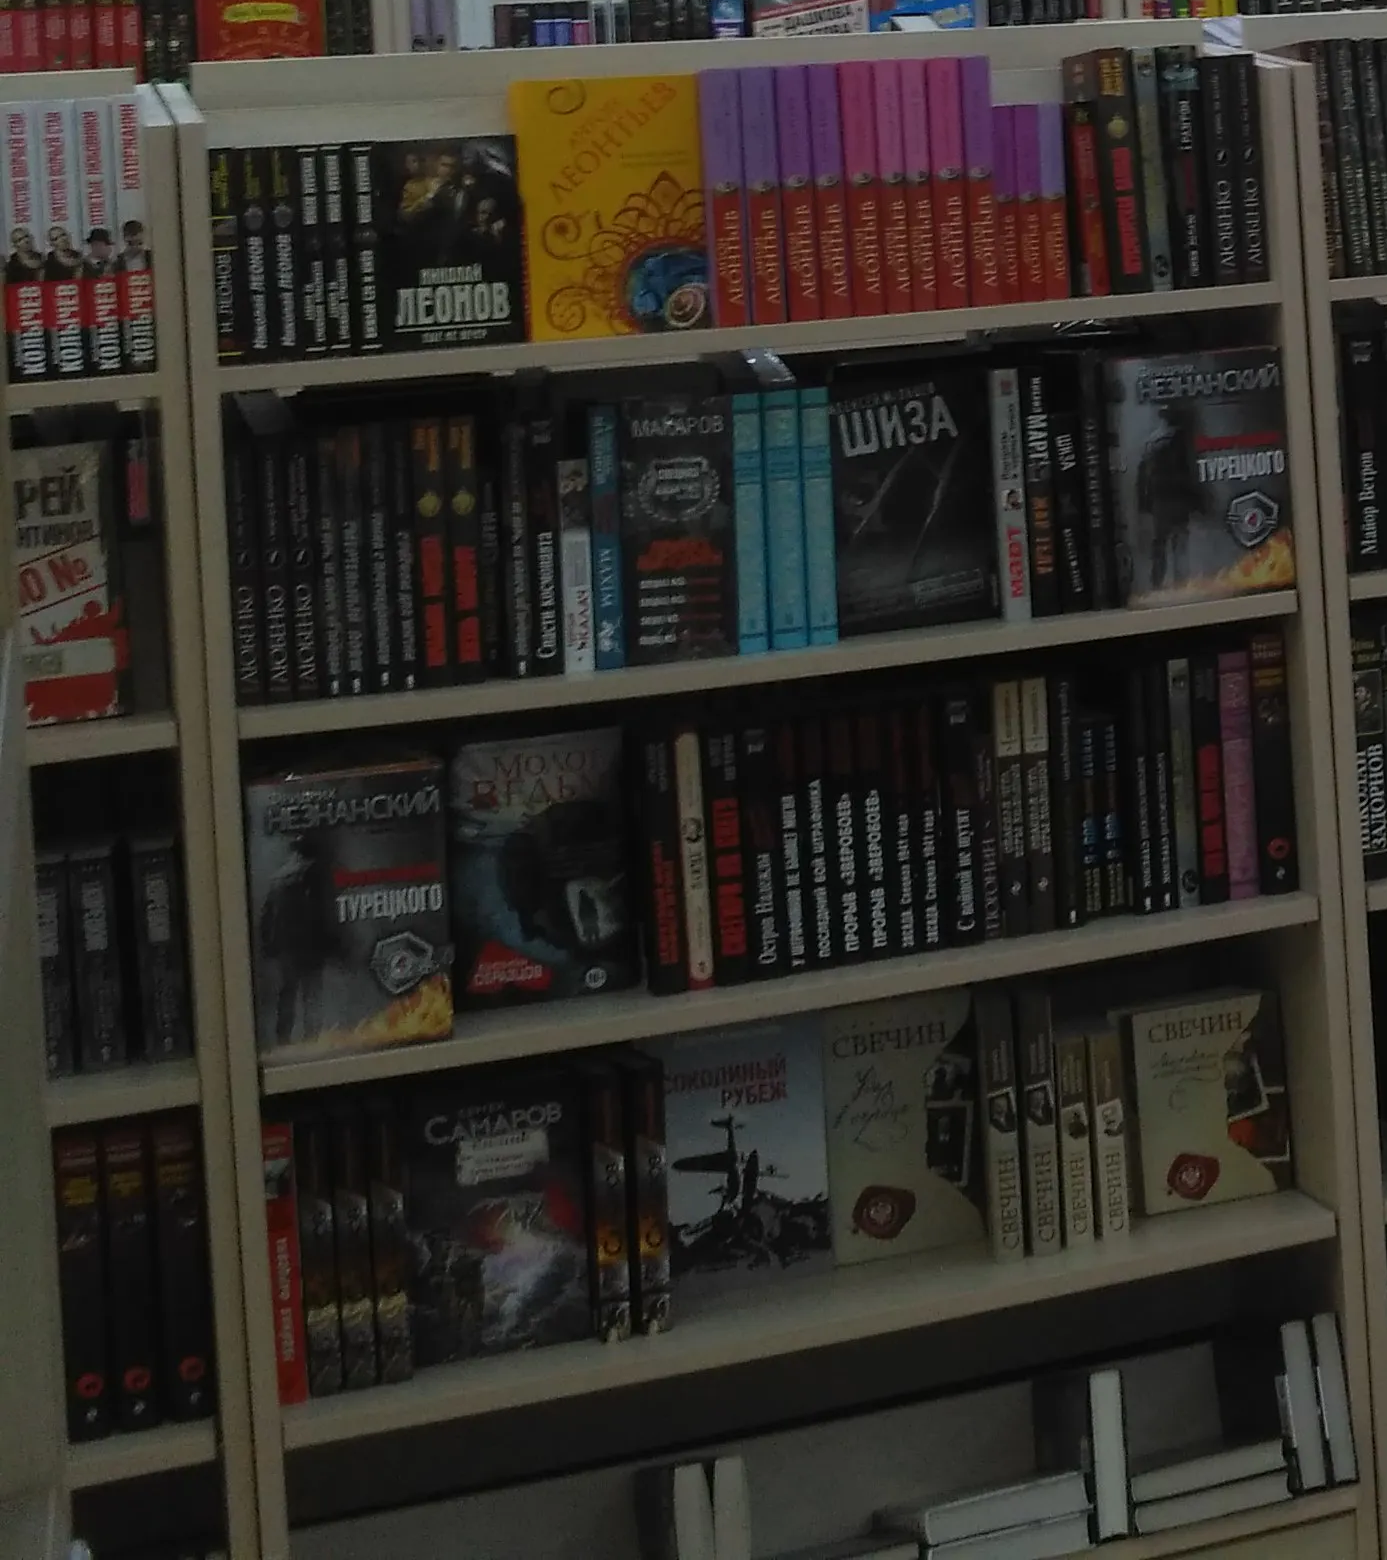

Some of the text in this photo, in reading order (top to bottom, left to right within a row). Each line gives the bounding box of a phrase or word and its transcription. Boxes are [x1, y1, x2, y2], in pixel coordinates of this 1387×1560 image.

[18, 285, 46, 376] КОЛЫЧЕВ
[55, 283, 84, 373] КОЛЫЧЕВ
[96, 281, 122, 371] КОЛЫЧЕВ
[128, 274, 154, 363] КОЛЫЧЕВ
[394, 282, 511, 328] ЛЕОНОВ
[1138, 364, 1280, 403] НЕЗНАНСКИЙ
[838, 395, 959, 459] ШИЗА
[1197, 449, 1285, 484] ТУРЕЦКОГО
[1357, 451, 1378, 555] Майор Ветров
[266, 783, 441, 834] НЕЗНАНСКИЙ
[335, 881, 445, 925] ТУРЕЦКОГО
[843, 891, 860, 952] ПРОРЫВ
[870, 887, 888, 948] ПРОРЫВ
[831, 1020, 948, 1060] СВЕЧИН
[1147, 1010, 1242, 1044] СВЕЧИН
[425, 1101, 563, 1145] САМАРОВ
[720, 1081, 789, 1110] РУБЕЖ
[999, 1155, 1021, 1251] СВЕЧИН
[1032, 1149, 1055, 1244] СВЕЧИН
[1070, 1151, 1088, 1236] СВЕЧИН
[1105, 1150, 1125, 1233] СВЕЧИН
